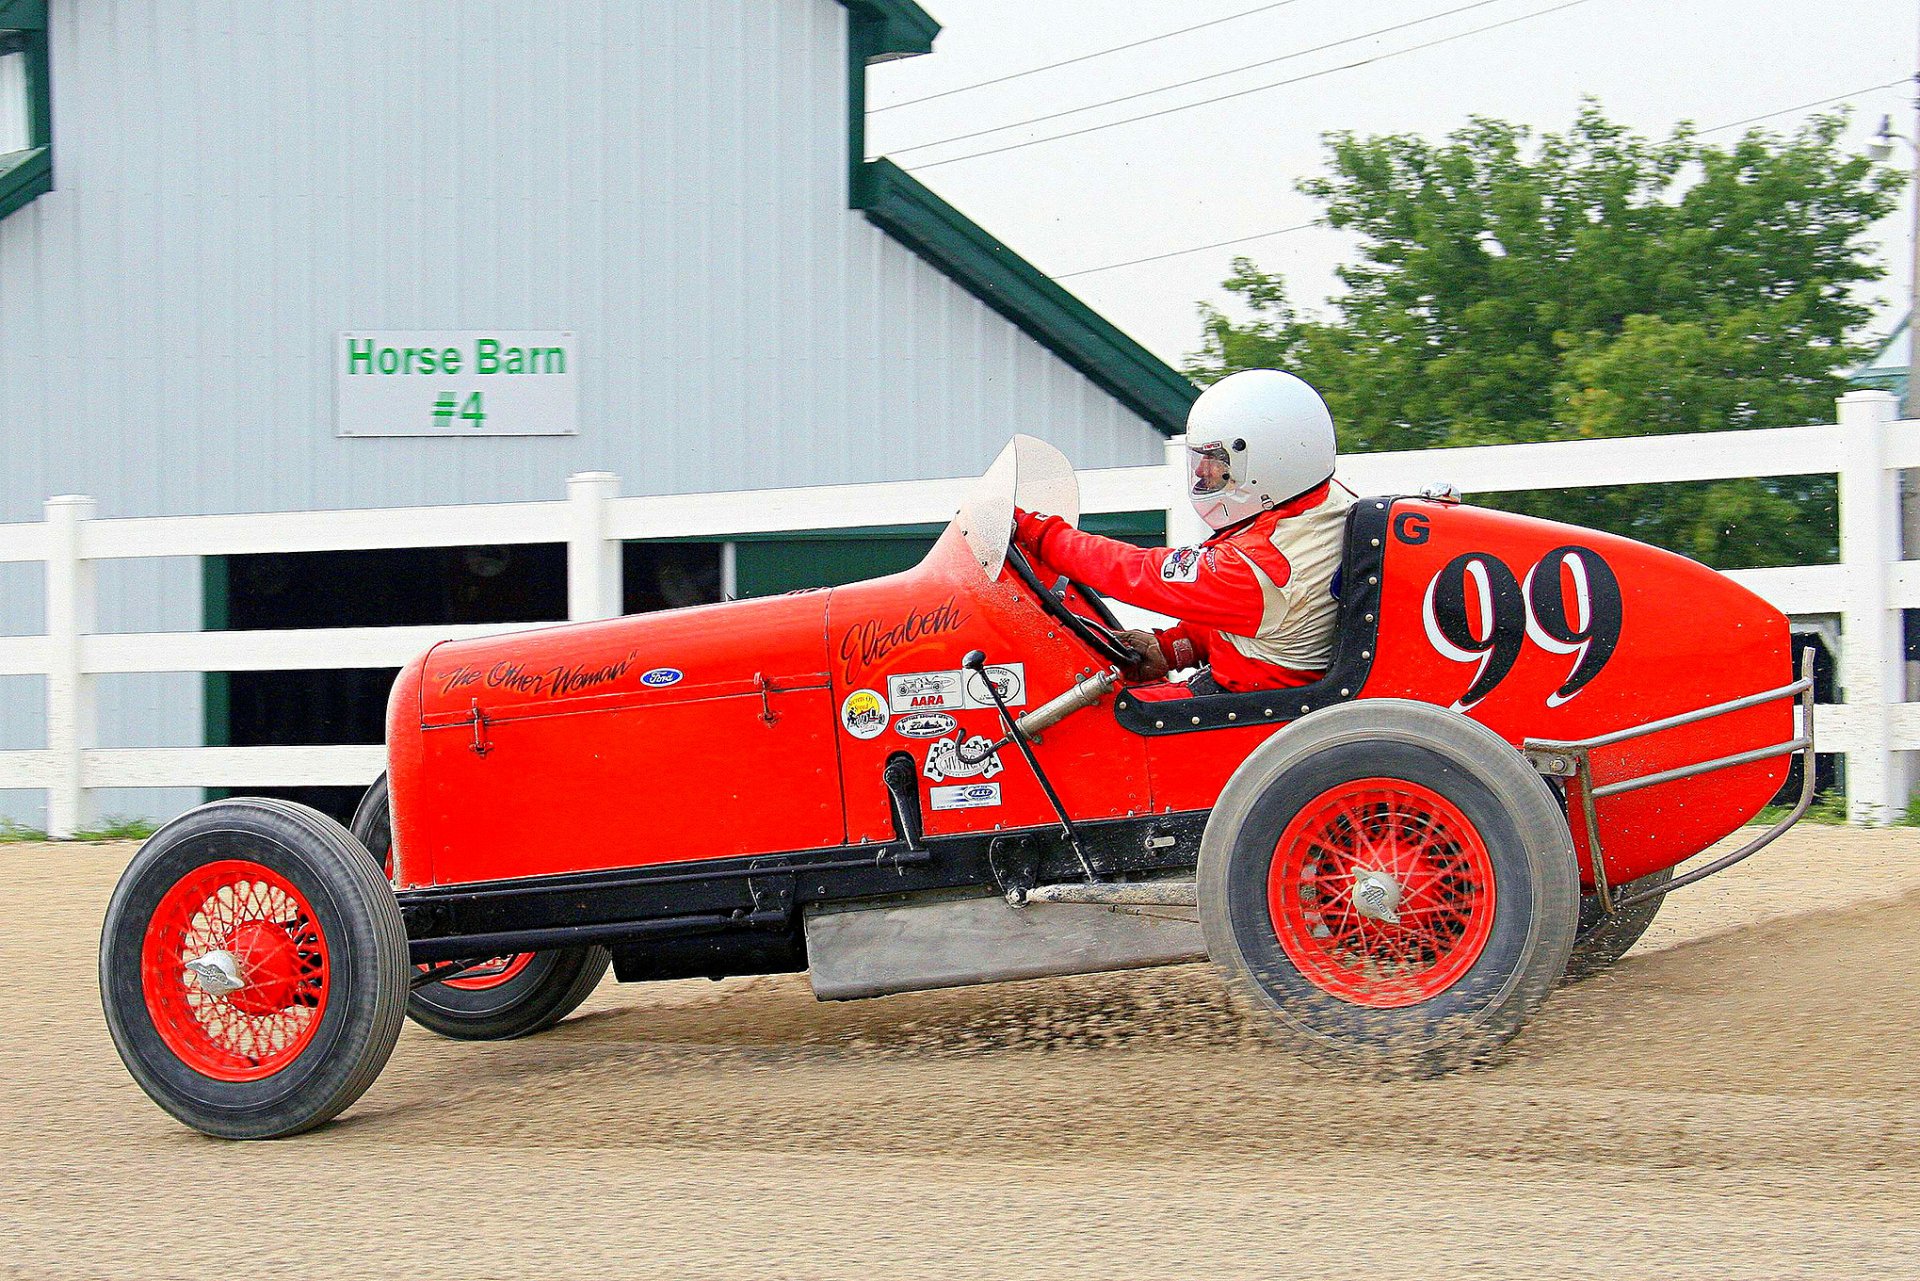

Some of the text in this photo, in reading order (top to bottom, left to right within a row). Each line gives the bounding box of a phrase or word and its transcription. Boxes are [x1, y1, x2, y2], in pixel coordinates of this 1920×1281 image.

[348, 338, 567, 375] Horse Barn
[431, 391, 487, 428] #4
[1393, 512, 1430, 545] G
[840, 595, 972, 685] Elizabeth
[1422, 545, 1623, 714] 99
[487, 661, 546, 693] Other
[649, 670, 675, 684] Ford
[910, 694, 945, 707] AARA
